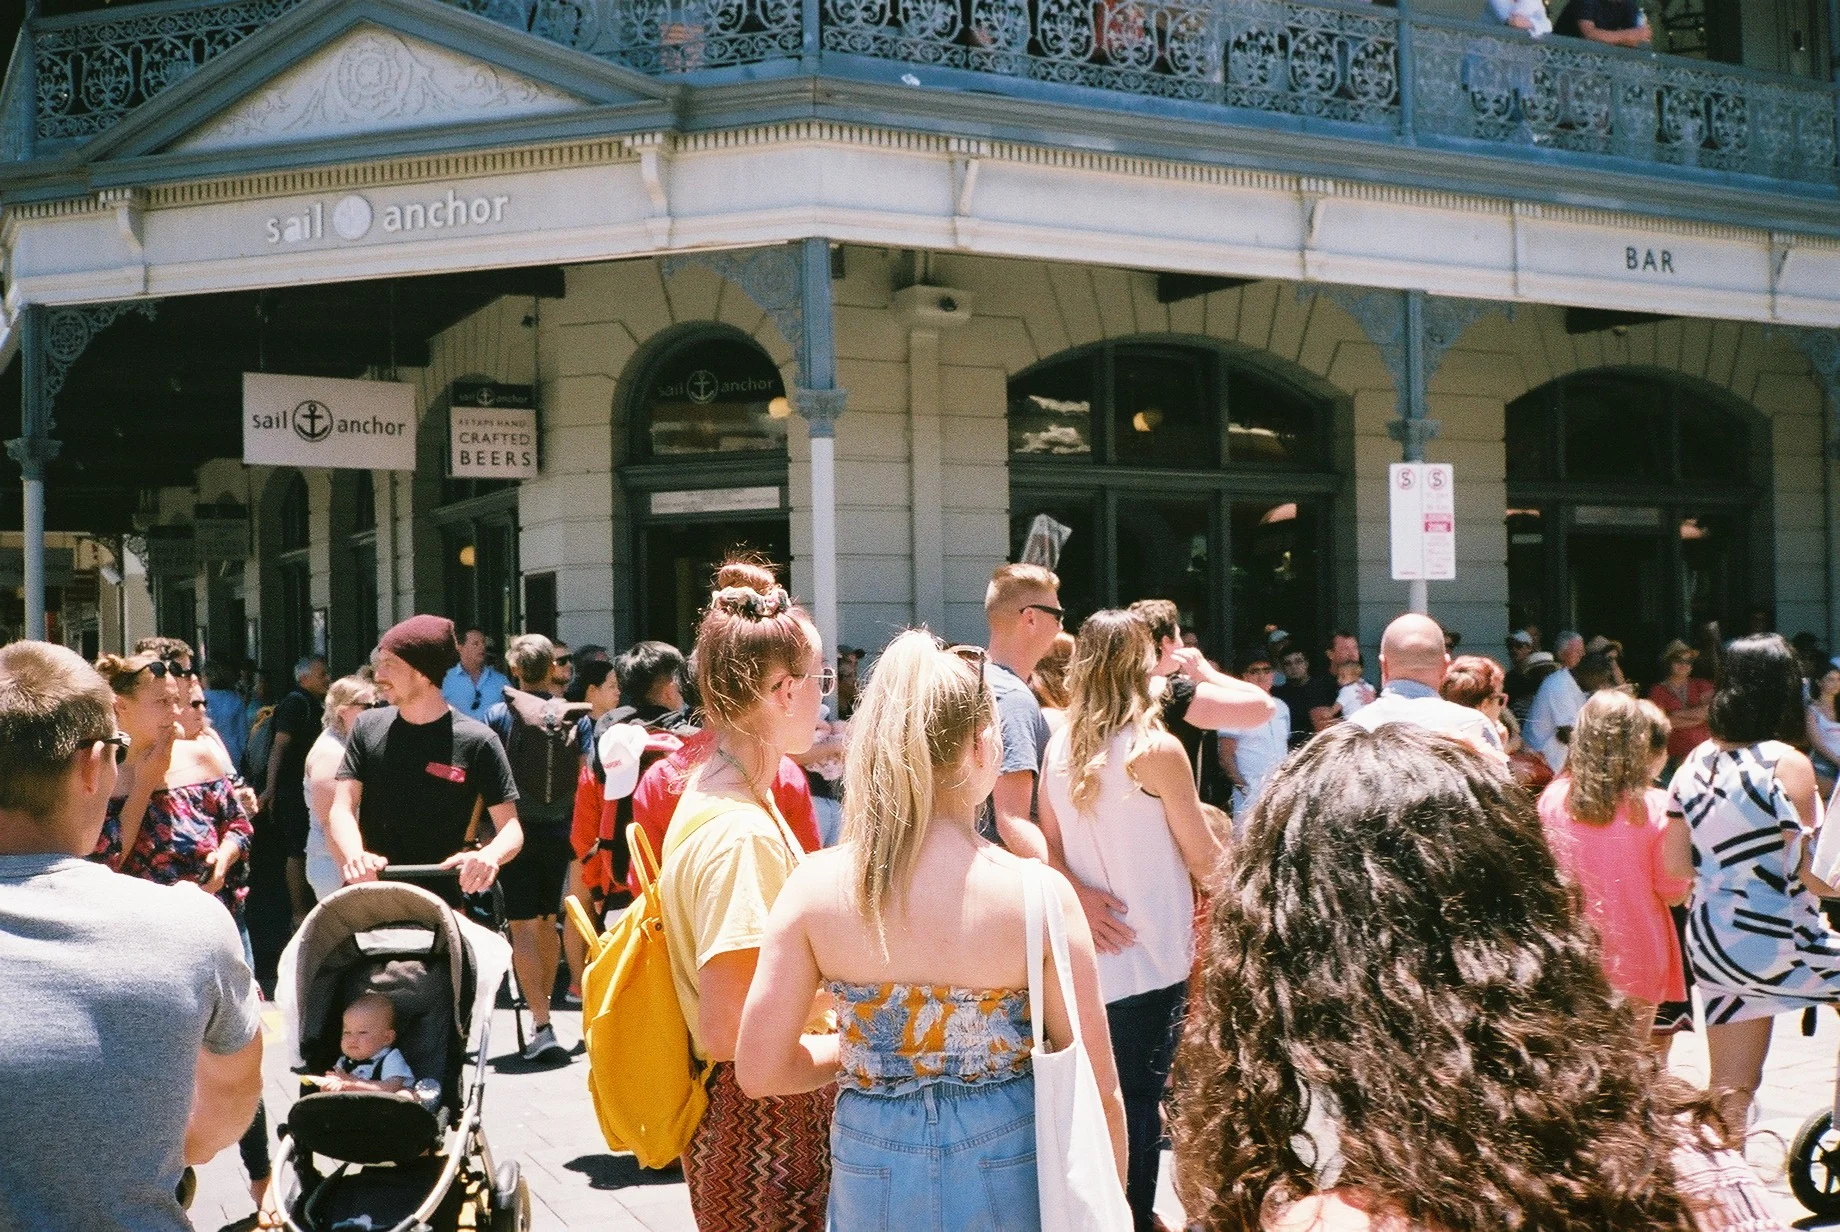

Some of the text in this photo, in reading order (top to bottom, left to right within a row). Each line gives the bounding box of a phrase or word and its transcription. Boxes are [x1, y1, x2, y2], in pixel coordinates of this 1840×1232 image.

[266, 189, 510, 243] sail anchor
[1625, 245, 1675, 275] BAR
[720, 376, 774, 394] anchor
[252, 410, 406, 437] sail anchor
[460, 431, 531, 446] CRAFTED
[460, 449, 531, 467] BEERS
